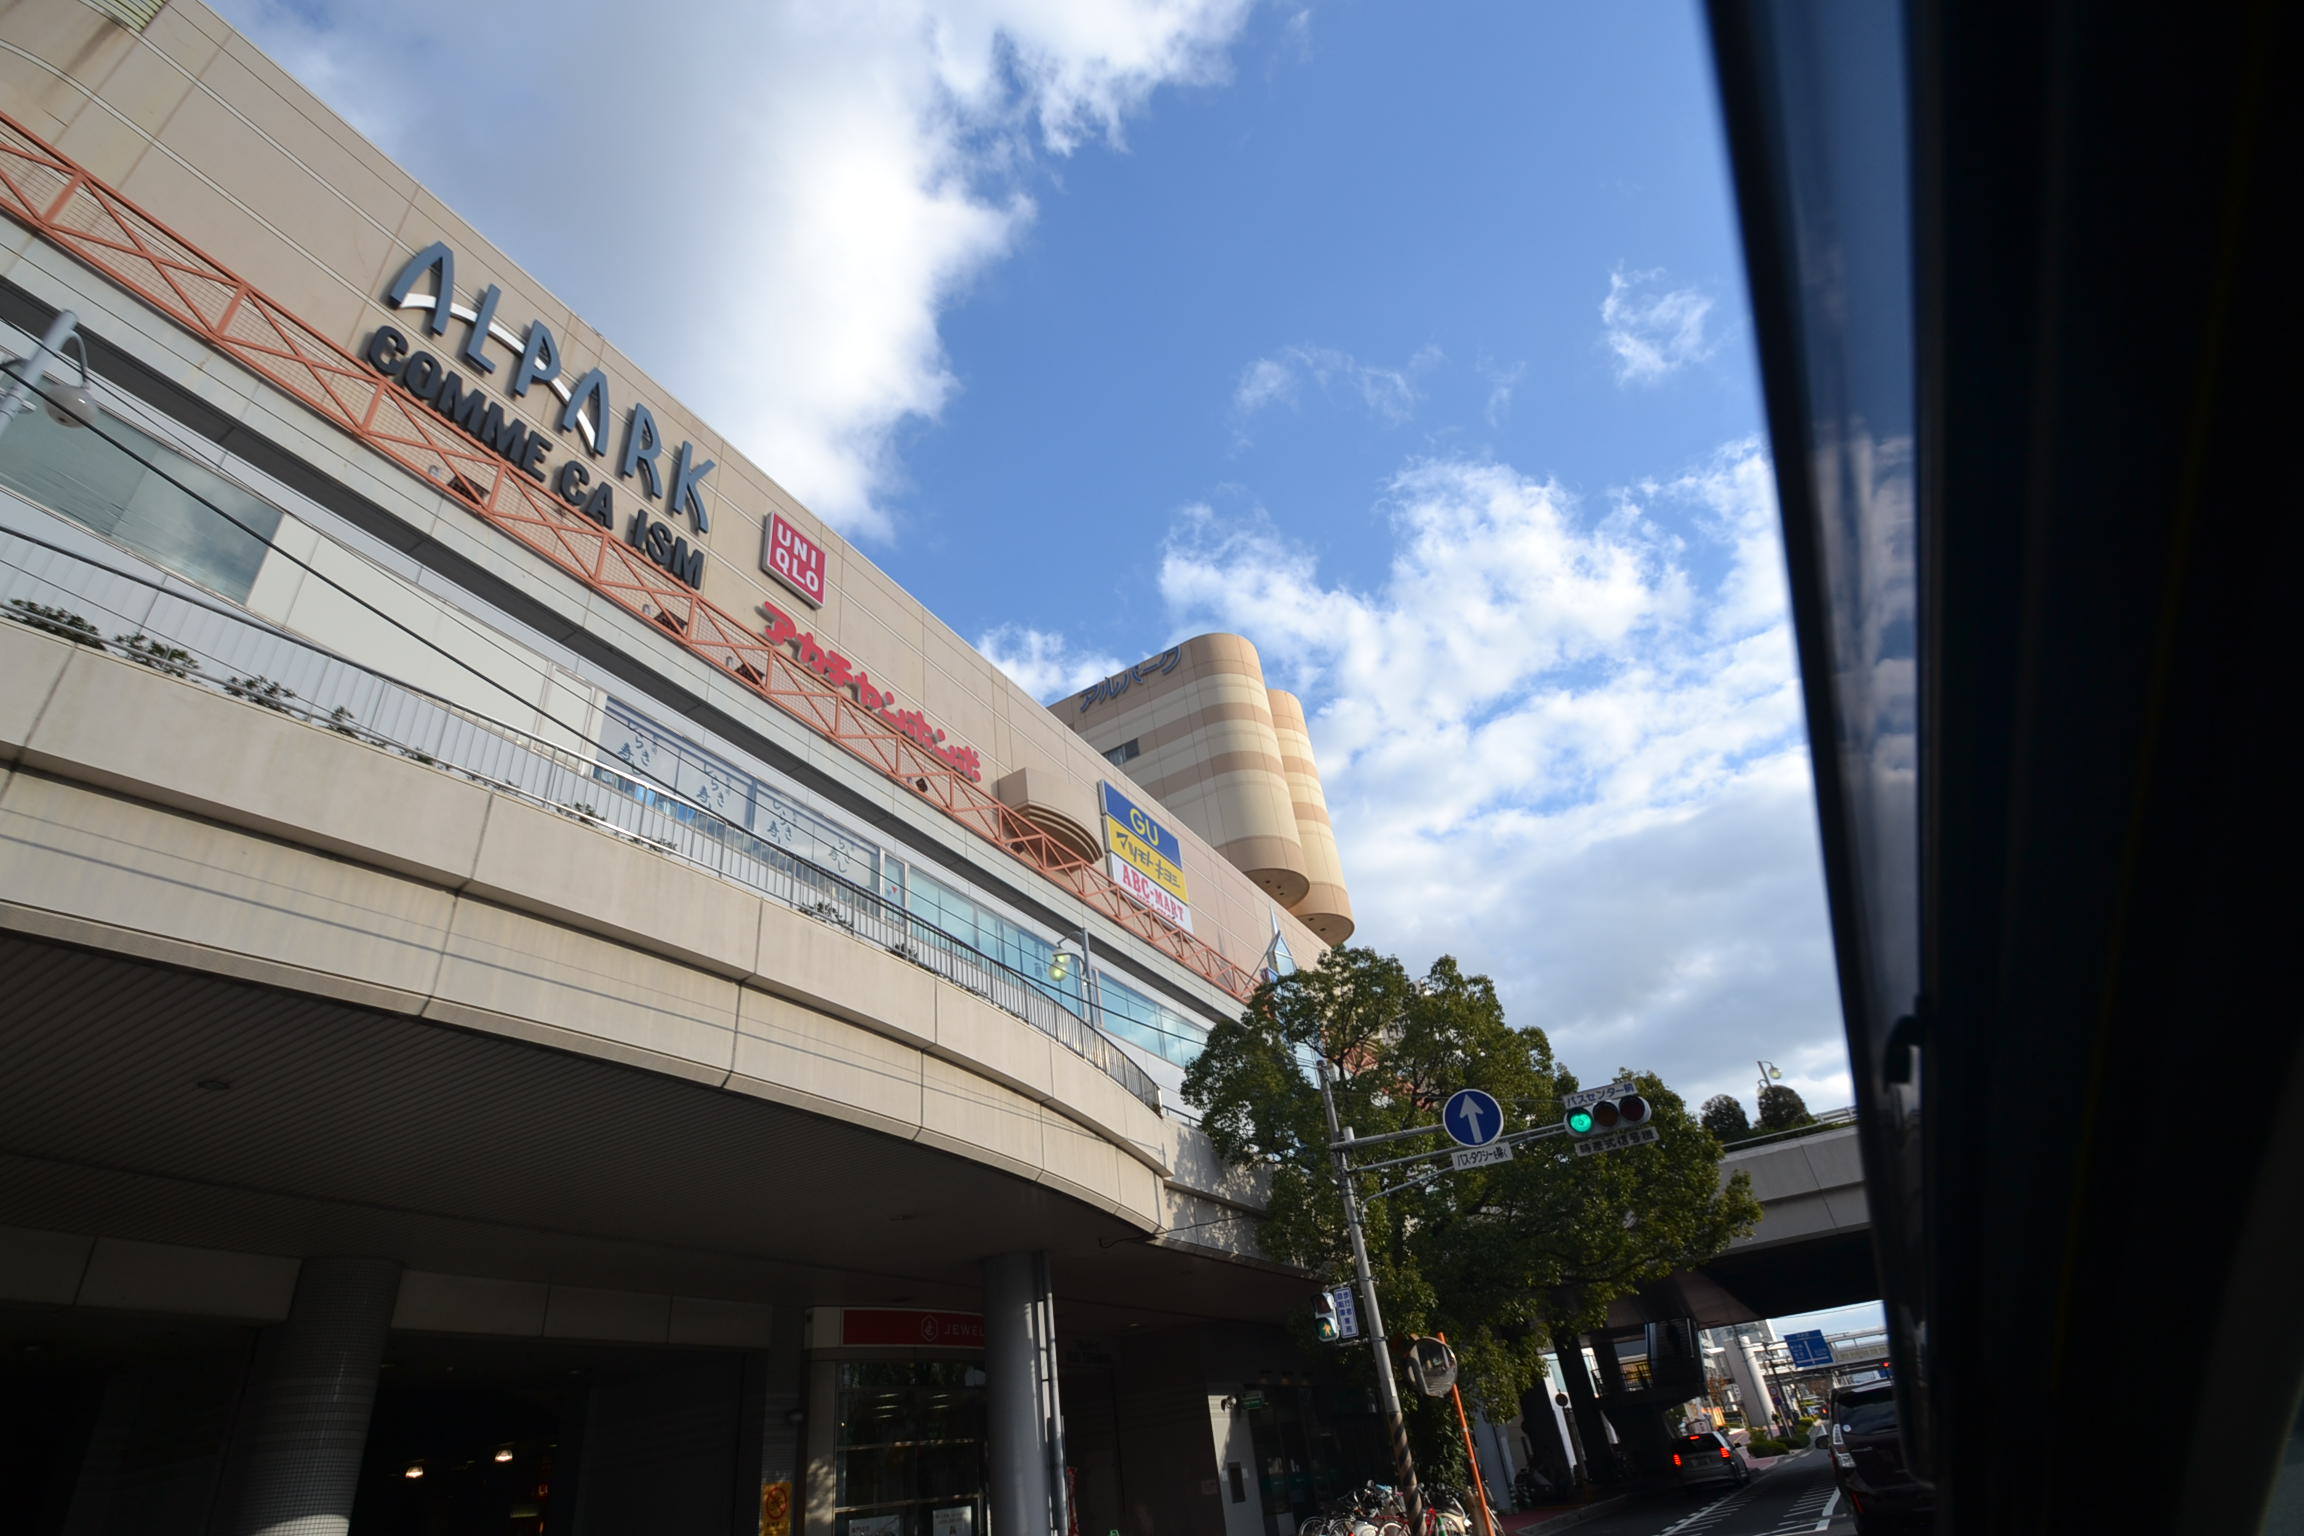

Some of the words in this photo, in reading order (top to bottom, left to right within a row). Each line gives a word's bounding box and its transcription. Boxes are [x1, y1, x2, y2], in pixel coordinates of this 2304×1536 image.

[389, 240, 717, 533] ALPARK
[367, 325, 553, 483] COMME
[560, 460, 614, 530] CA
[632, 508, 705, 590] ISM
[775, 547, 820, 592] QLO
[777, 522, 817, 570] UNI
[1080, 646, 1182, 713] アルパーク
[1129, 808, 1159, 846] GU
[1116, 831, 1181, 888] マツモトキヨシ
[1122, 863, 1185, 922] ABC-MART
